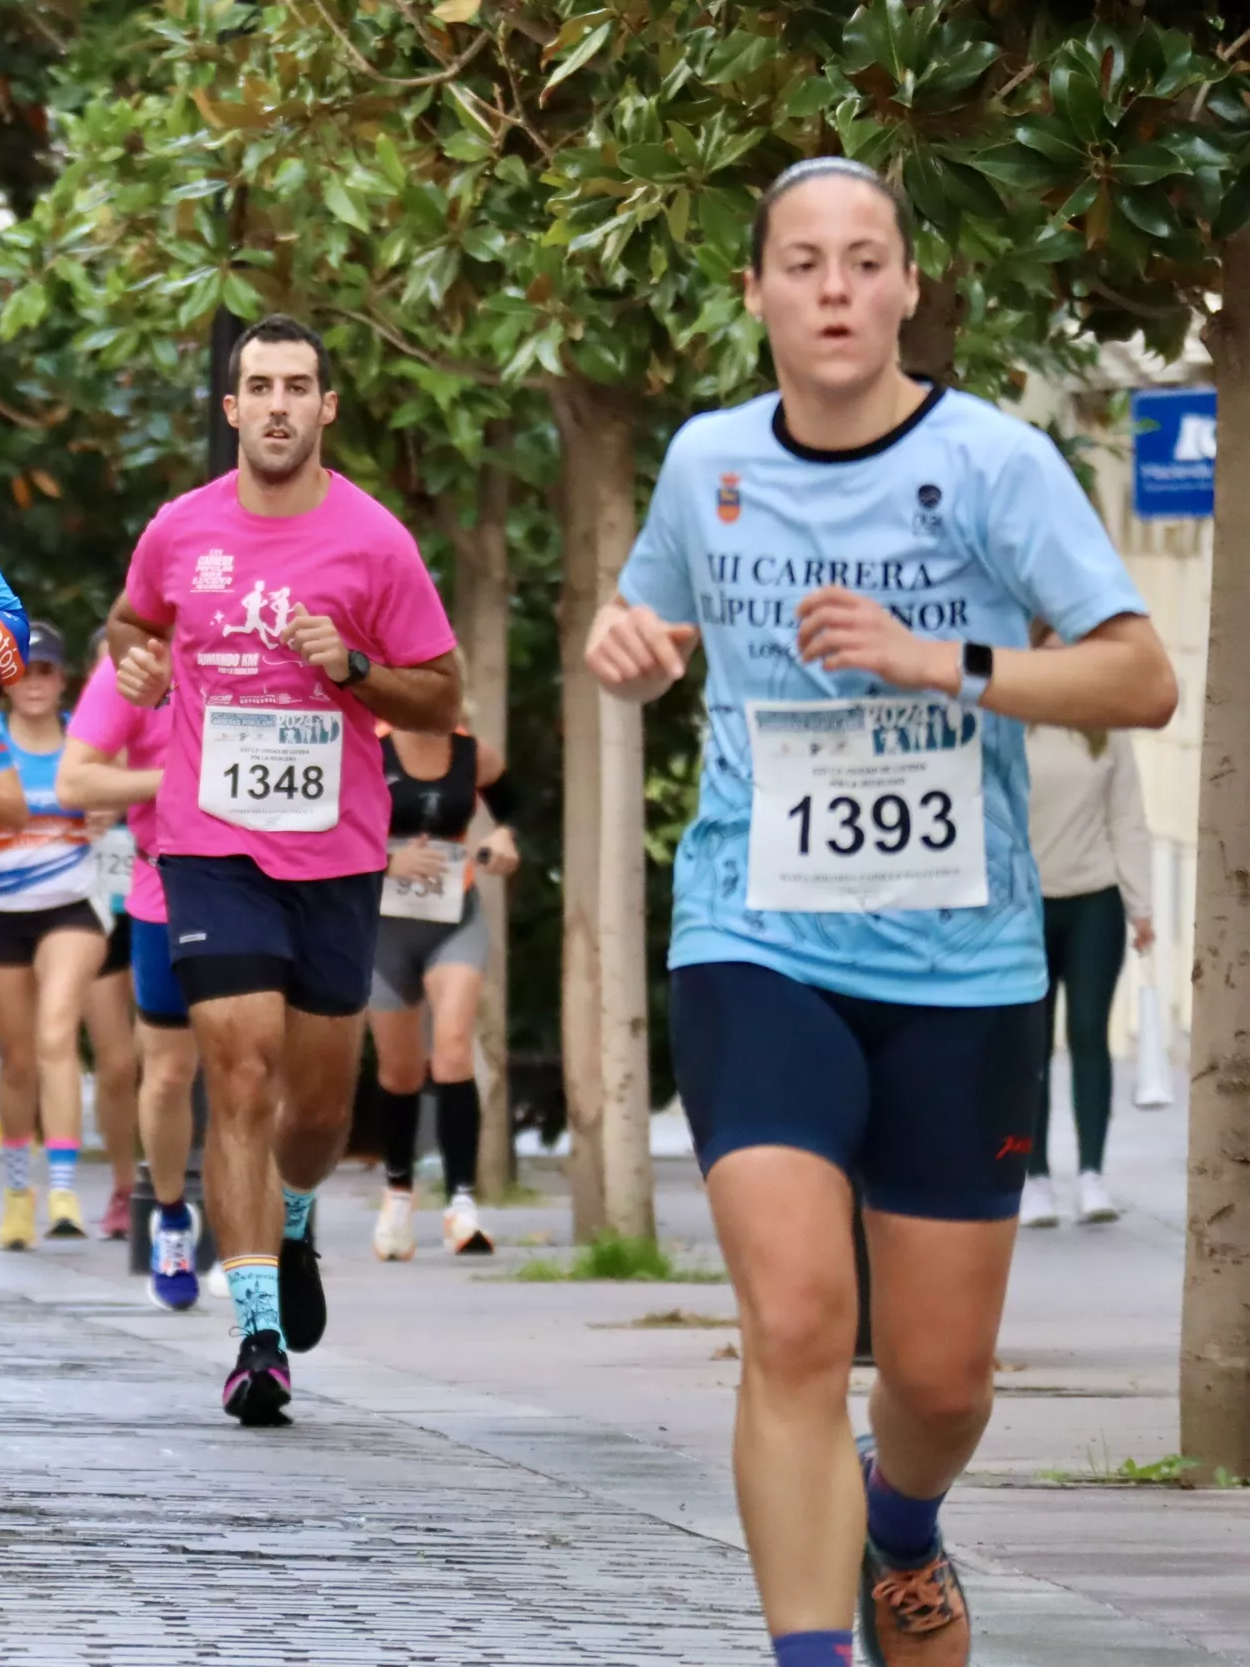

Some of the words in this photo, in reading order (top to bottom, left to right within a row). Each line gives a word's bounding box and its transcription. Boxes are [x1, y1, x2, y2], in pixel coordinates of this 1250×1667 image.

[753, 556, 934, 592] CARRERA
[223, 763, 324, 801] 1348
[788, 790, 957, 856] 1393
